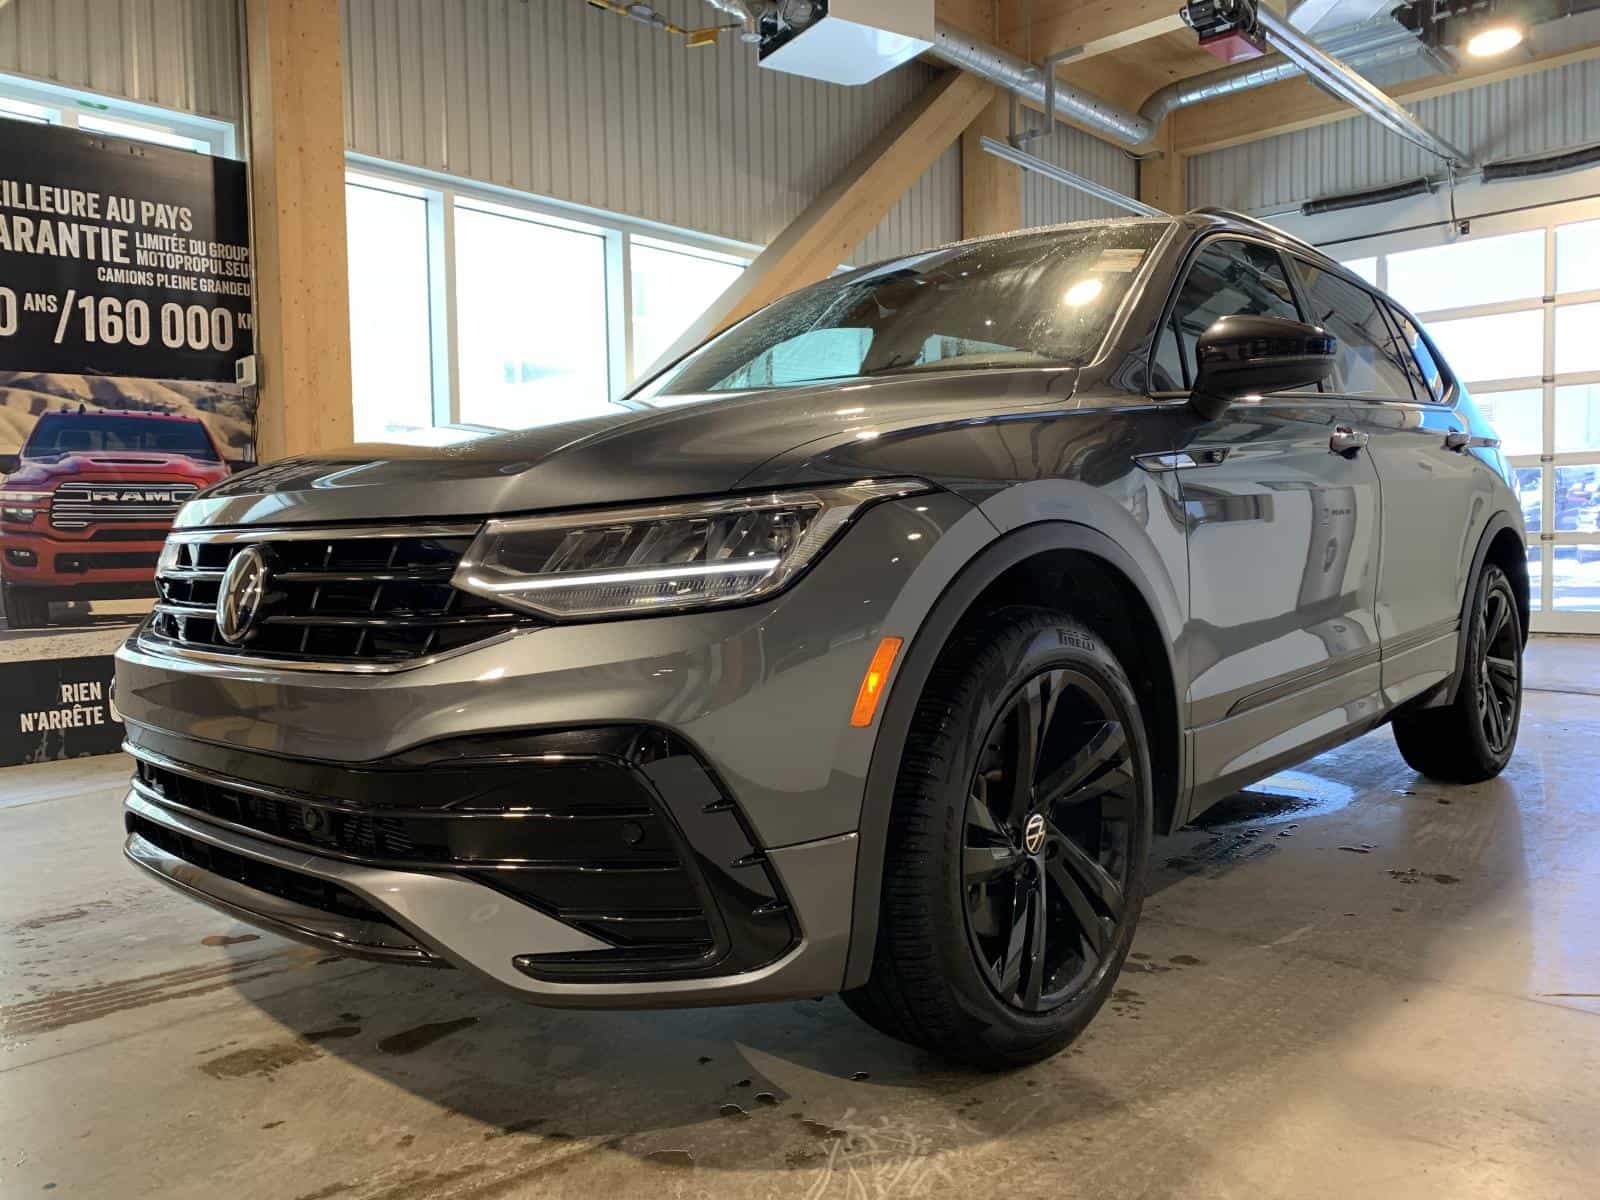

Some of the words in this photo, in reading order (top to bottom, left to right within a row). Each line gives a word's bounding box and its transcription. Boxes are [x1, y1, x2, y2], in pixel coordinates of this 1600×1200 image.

[0, 179, 100, 219] ILLEURE
[106, 195, 135, 224] AU
[141, 201, 193, 232] PAYS
[136, 231, 187, 252] LIMITÉE
[189, 239, 207, 257] DU
[209, 241, 249, 262] GROUP
[136, 250, 250, 278] MOTOPROPULSEU
[97, 266, 154, 287] CAMIONS
[156, 275, 197, 291] PLEINE
[200, 277, 251, 297] GRANDEU
[24, 292, 58, 313] ANS
[161, 302, 234, 351] 000
[93, 491, 170, 502] RAM
[1056, 627, 1096, 652] PIRELLI
[62, 681, 101, 703] RIEN
